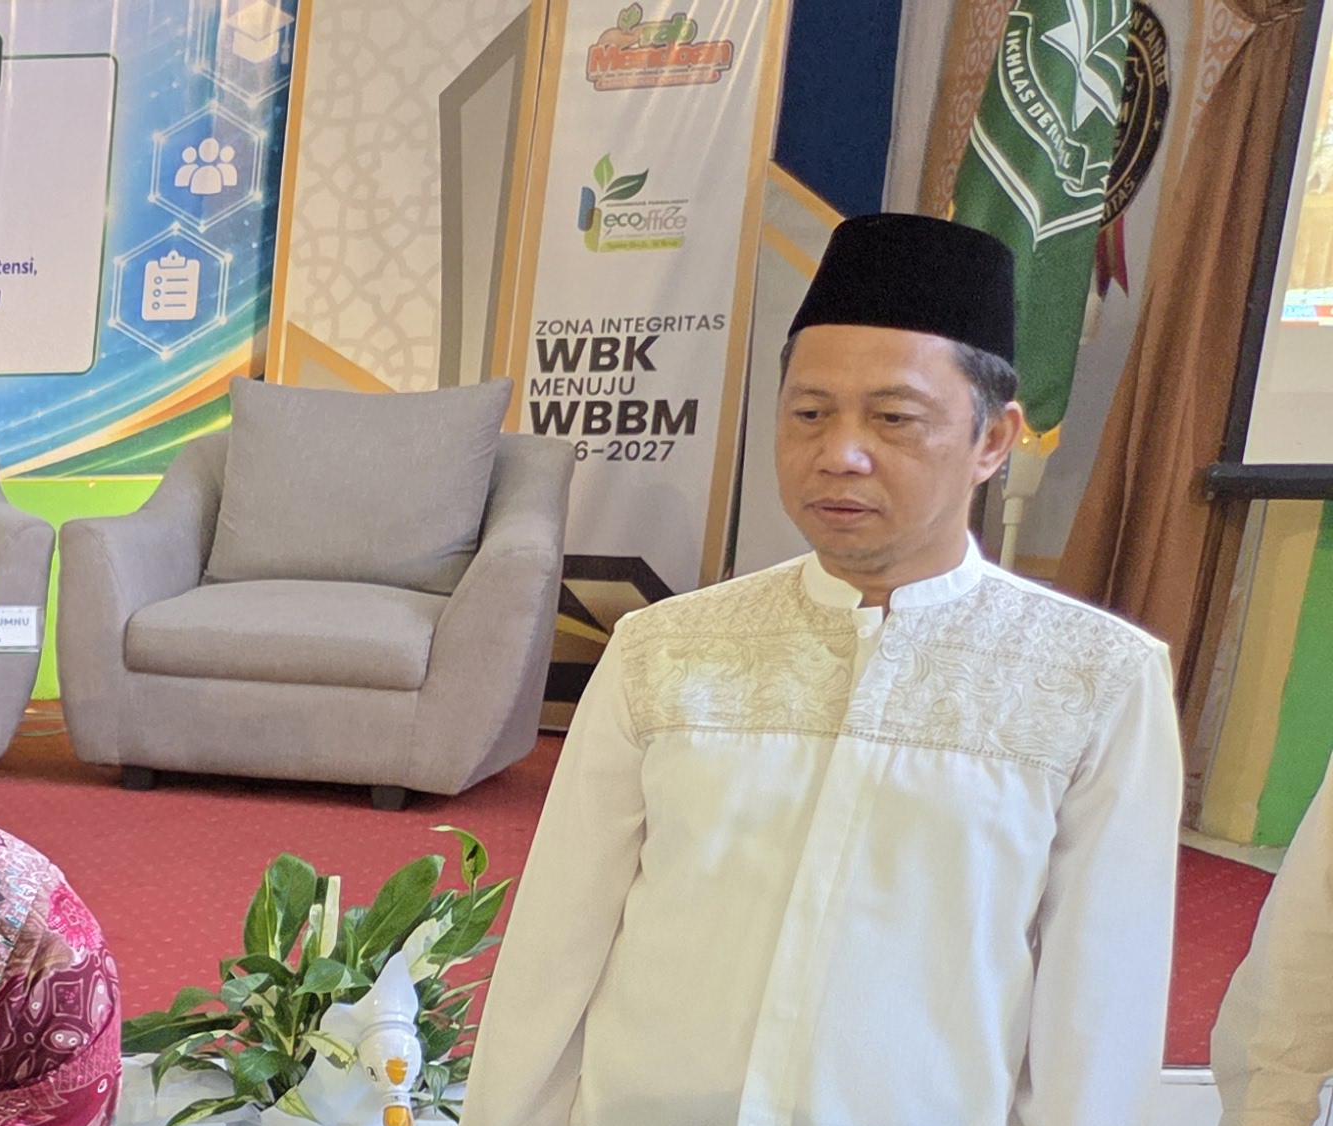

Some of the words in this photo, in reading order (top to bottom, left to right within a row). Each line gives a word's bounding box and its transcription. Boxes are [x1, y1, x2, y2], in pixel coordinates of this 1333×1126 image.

[1007, 30, 1035, 103] IKHLAS
[535, 319, 594, 336] ZONA
[601, 314, 726, 334] INTEGRITAS
[535, 335, 660, 373] WBK
[529, 376, 635, 396] MENUJU
[529, 399, 699, 437] WBBM
[574, 440, 675, 462] 6-2027
